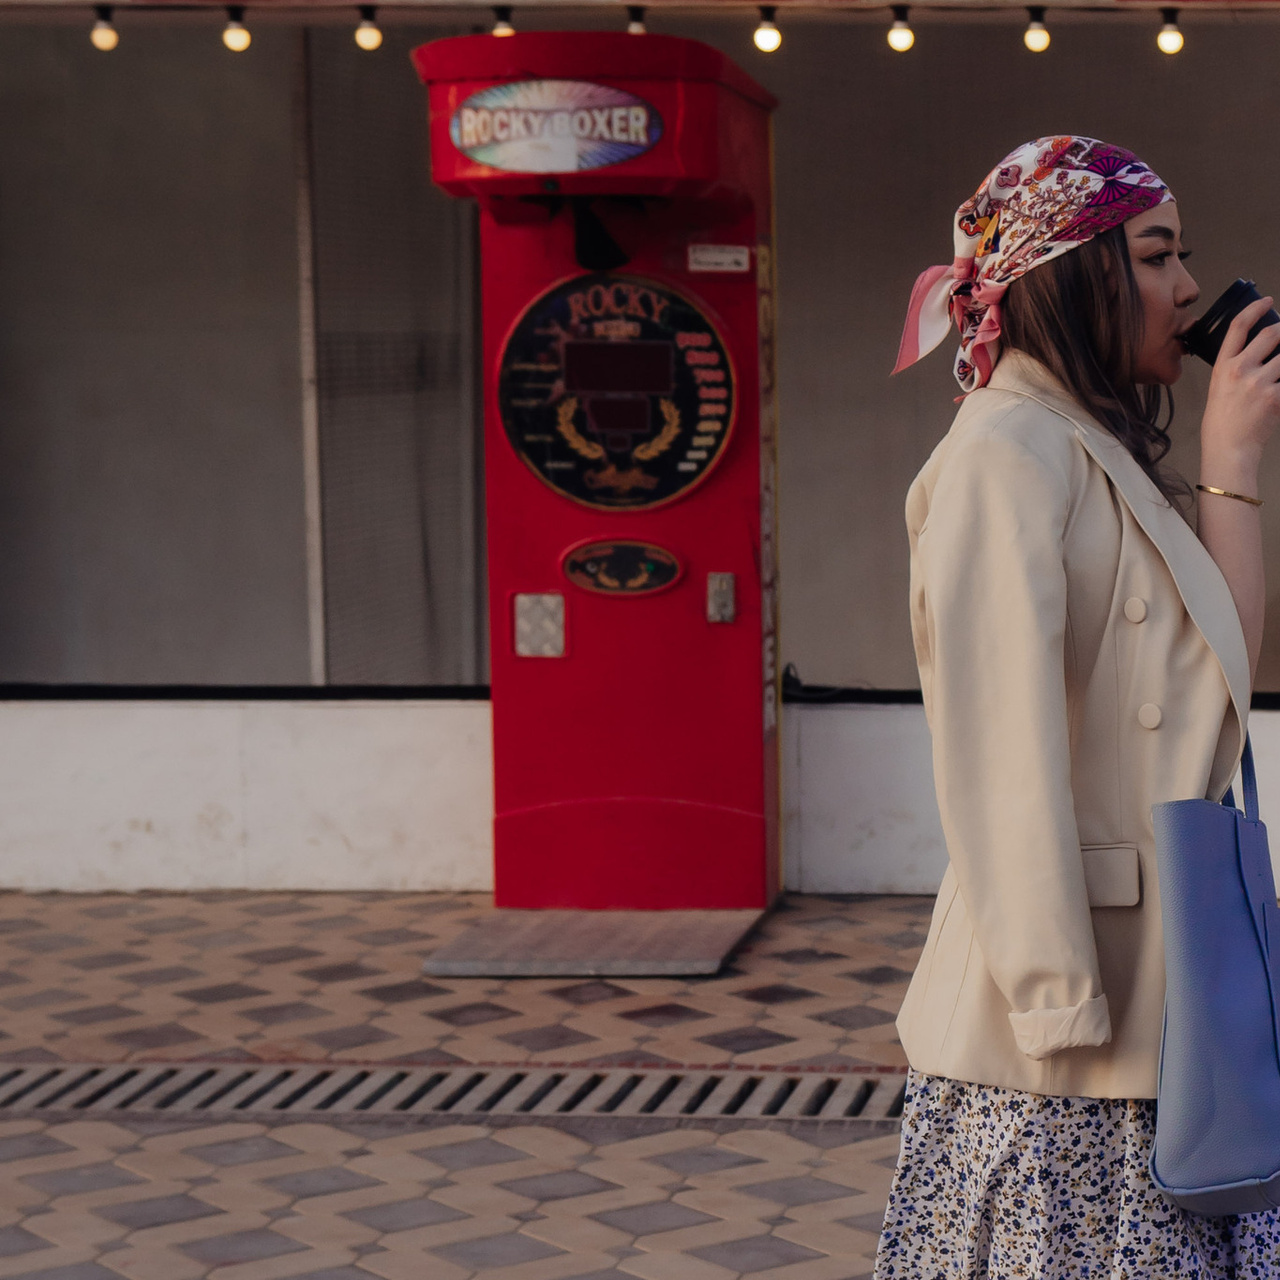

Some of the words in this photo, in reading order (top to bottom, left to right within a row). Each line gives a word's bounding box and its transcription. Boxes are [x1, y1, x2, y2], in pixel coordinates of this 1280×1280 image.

[460, 106, 545, 148] ROCKY
[550, 105, 649, 145] BOXER
[567, 282, 670, 323] ROCKY
